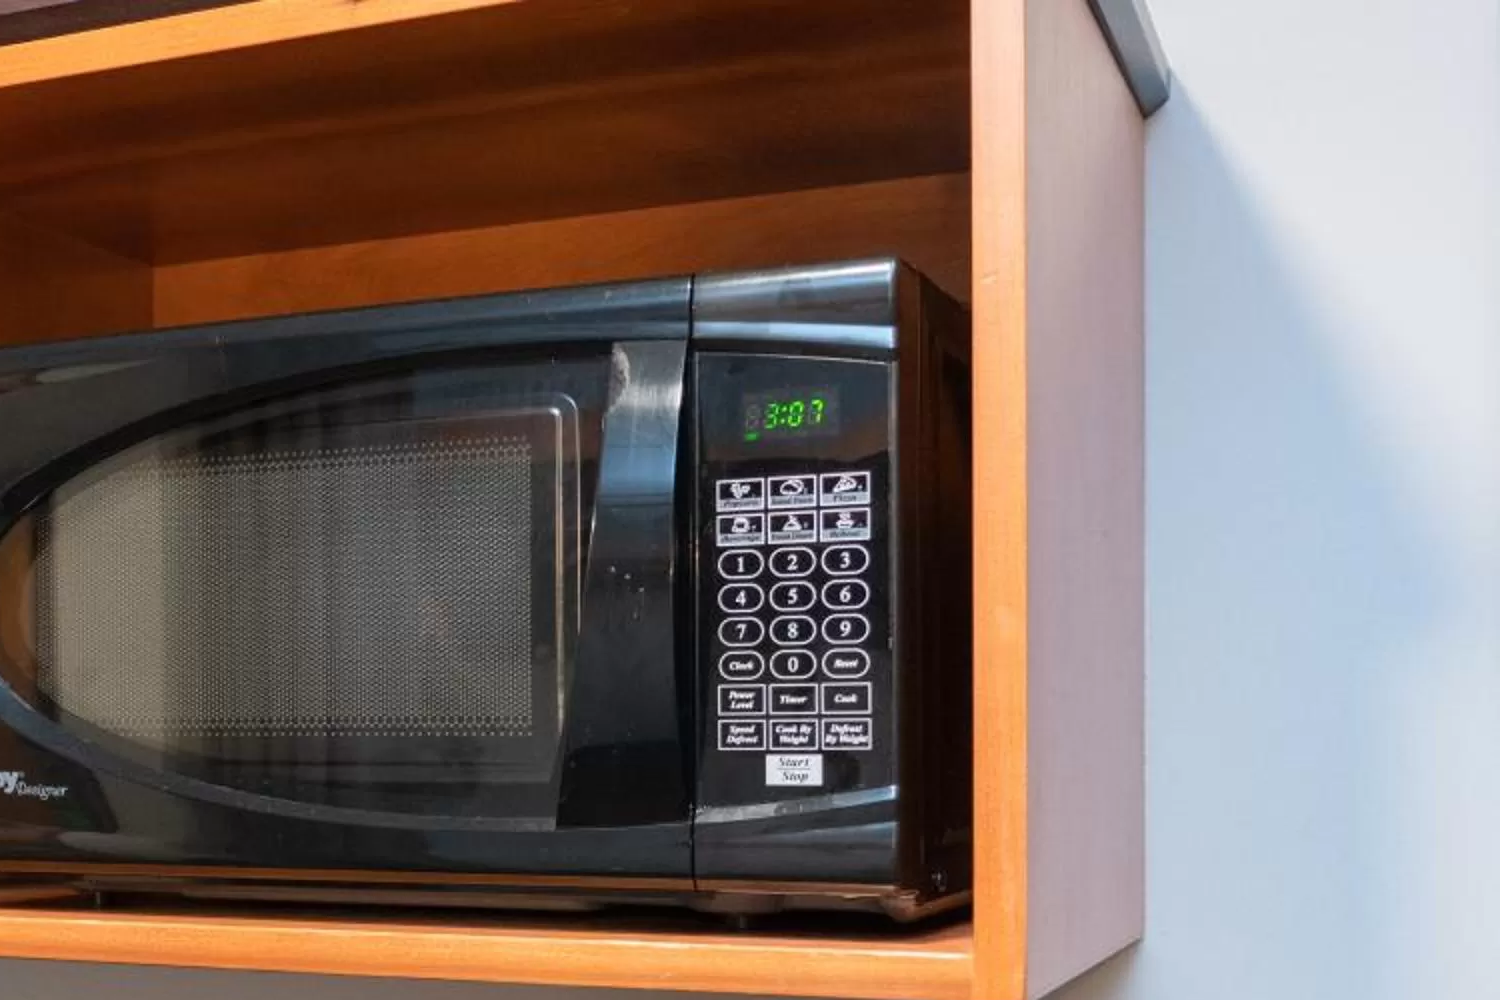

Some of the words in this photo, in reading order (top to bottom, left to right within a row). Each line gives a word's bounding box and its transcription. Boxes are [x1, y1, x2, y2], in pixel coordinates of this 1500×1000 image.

[765, 399, 825, 429] 3:07
[736, 556, 745, 573] 1
[787, 554, 798, 570] 2
[839, 552, 851, 568] 3
[735, 590, 746, 606] 4
[787, 588, 798, 604] 5
[839, 586, 851, 602] 6
[735, 623, 747, 640] 7
[787, 622, 799, 638] 8
[839, 620, 851, 637] 9
[729, 660, 754, 671] Clock
[787, 656, 799, 673] 0
[833, 658, 858, 669] Reset
[728, 690, 755, 700] Power
[779, 694, 808, 704] Timer
[834, 694, 857, 703] Cook
[731, 700, 754, 709] Level
[729, 725, 755, 736] Speed
[775, 725, 798, 734] Cook
[799, 725, 812, 735] By
[830, 724, 863, 734] Defrost
[726, 734, 758, 744] Defrost
[779, 734, 809, 745] Weight
[825, 733, 838, 744] By
[778, 757, 810, 767] Start
[782, 771, 810, 782] Stop
[17, 781, 68, 800] Designer
